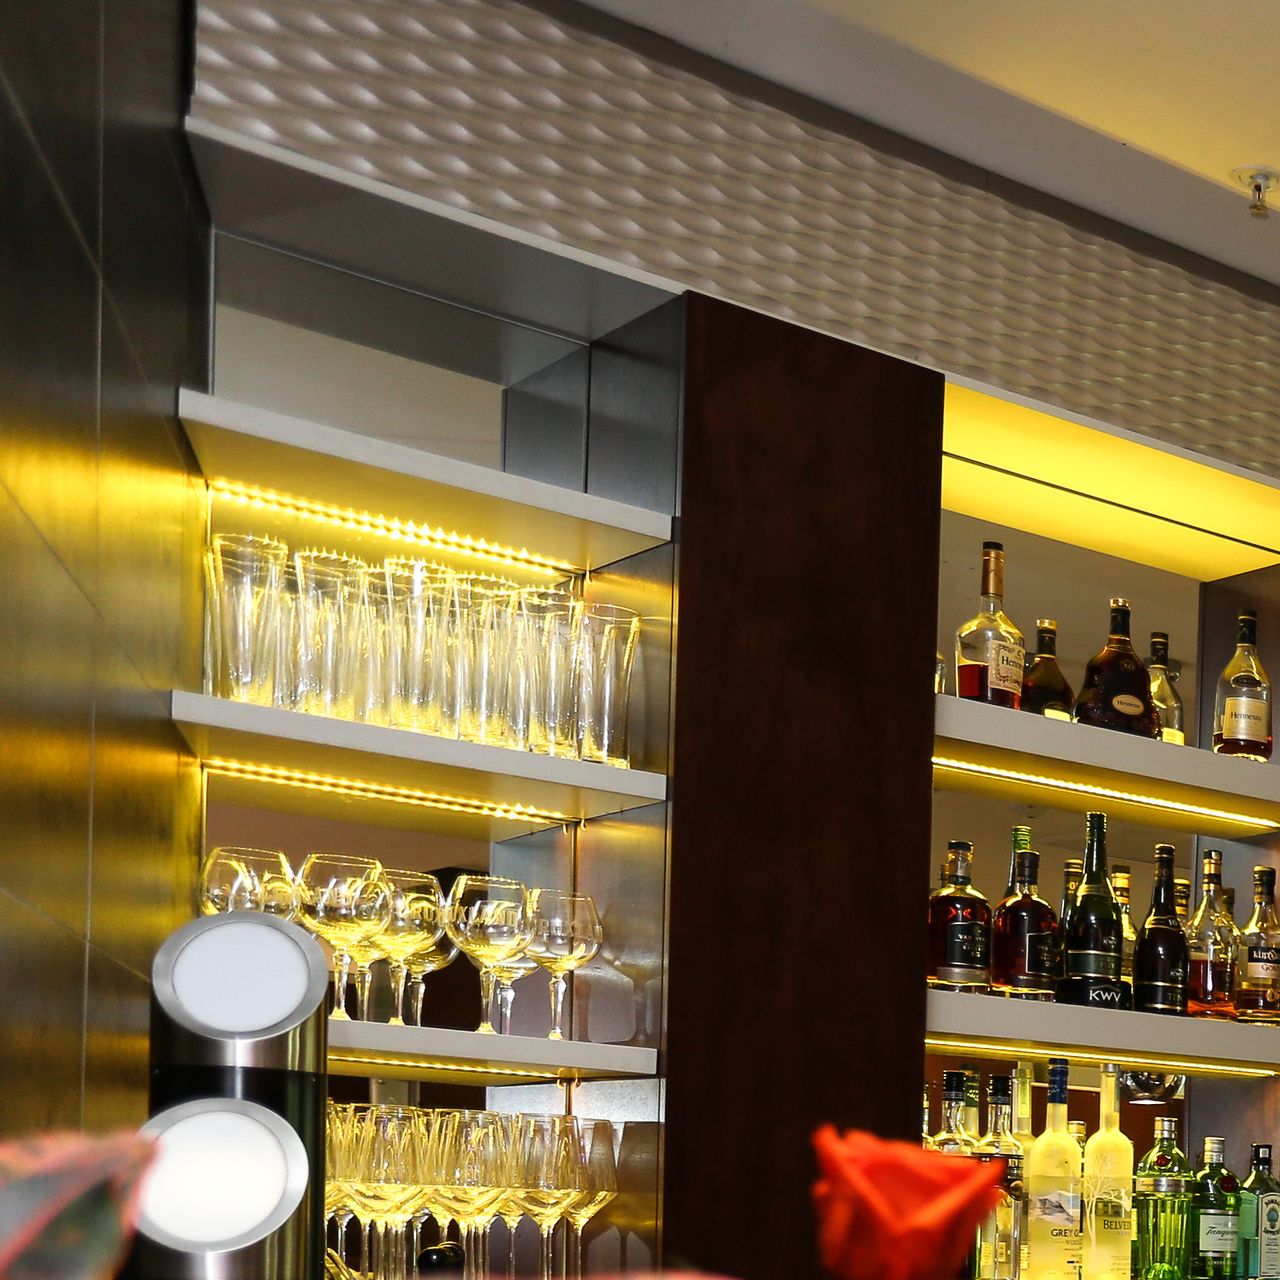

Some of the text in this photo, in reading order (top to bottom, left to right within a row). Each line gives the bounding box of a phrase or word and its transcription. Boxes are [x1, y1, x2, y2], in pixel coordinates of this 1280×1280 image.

[1230, 711, 1262, 722] Hennessy
[1089, 990, 1122, 1002] KWV
[1050, 1228, 1072, 1238] GREY
